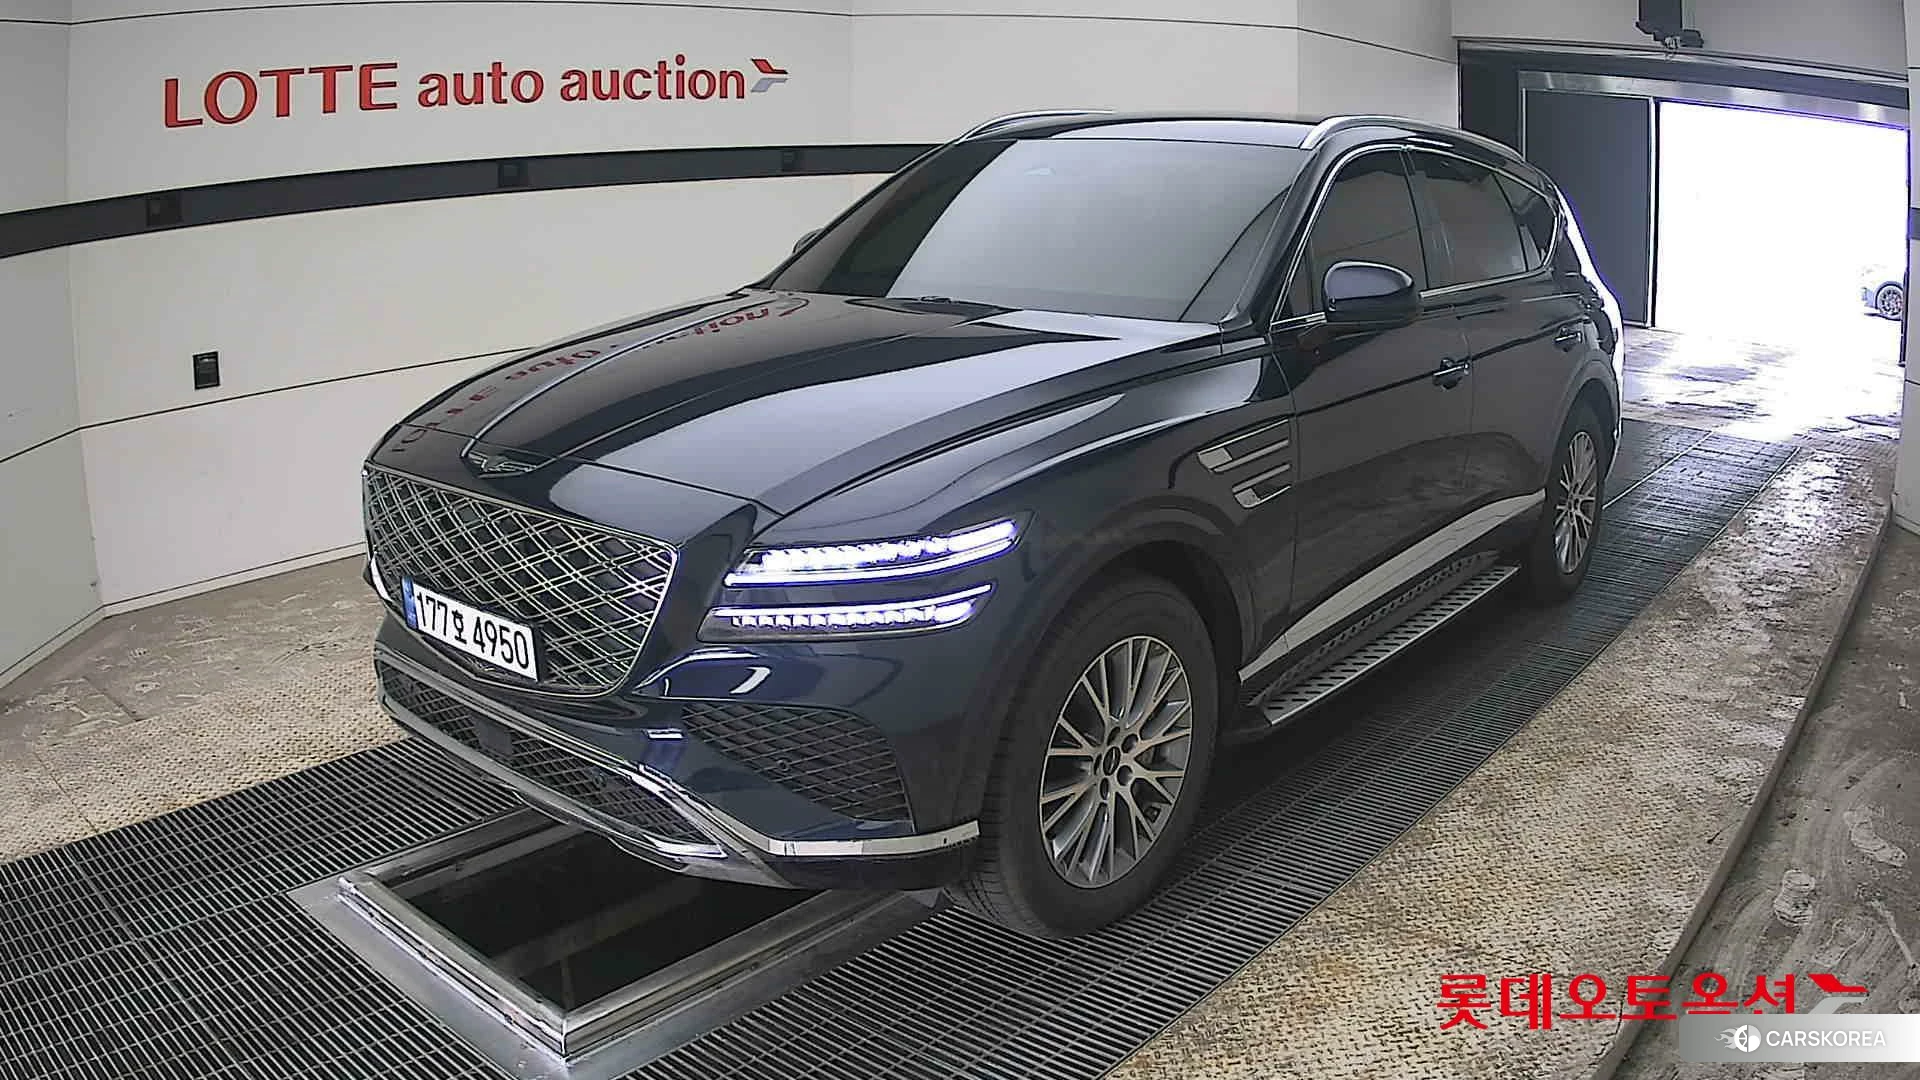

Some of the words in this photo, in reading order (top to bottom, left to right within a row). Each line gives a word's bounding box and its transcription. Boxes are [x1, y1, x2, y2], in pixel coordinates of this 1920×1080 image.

[165, 62, 398, 128] LOTTE
[417, 61, 545, 107] auto
[560, 54, 745, 100] auction
[416, 591, 467, 645] 177호
[473, 616, 529, 669] 4950
